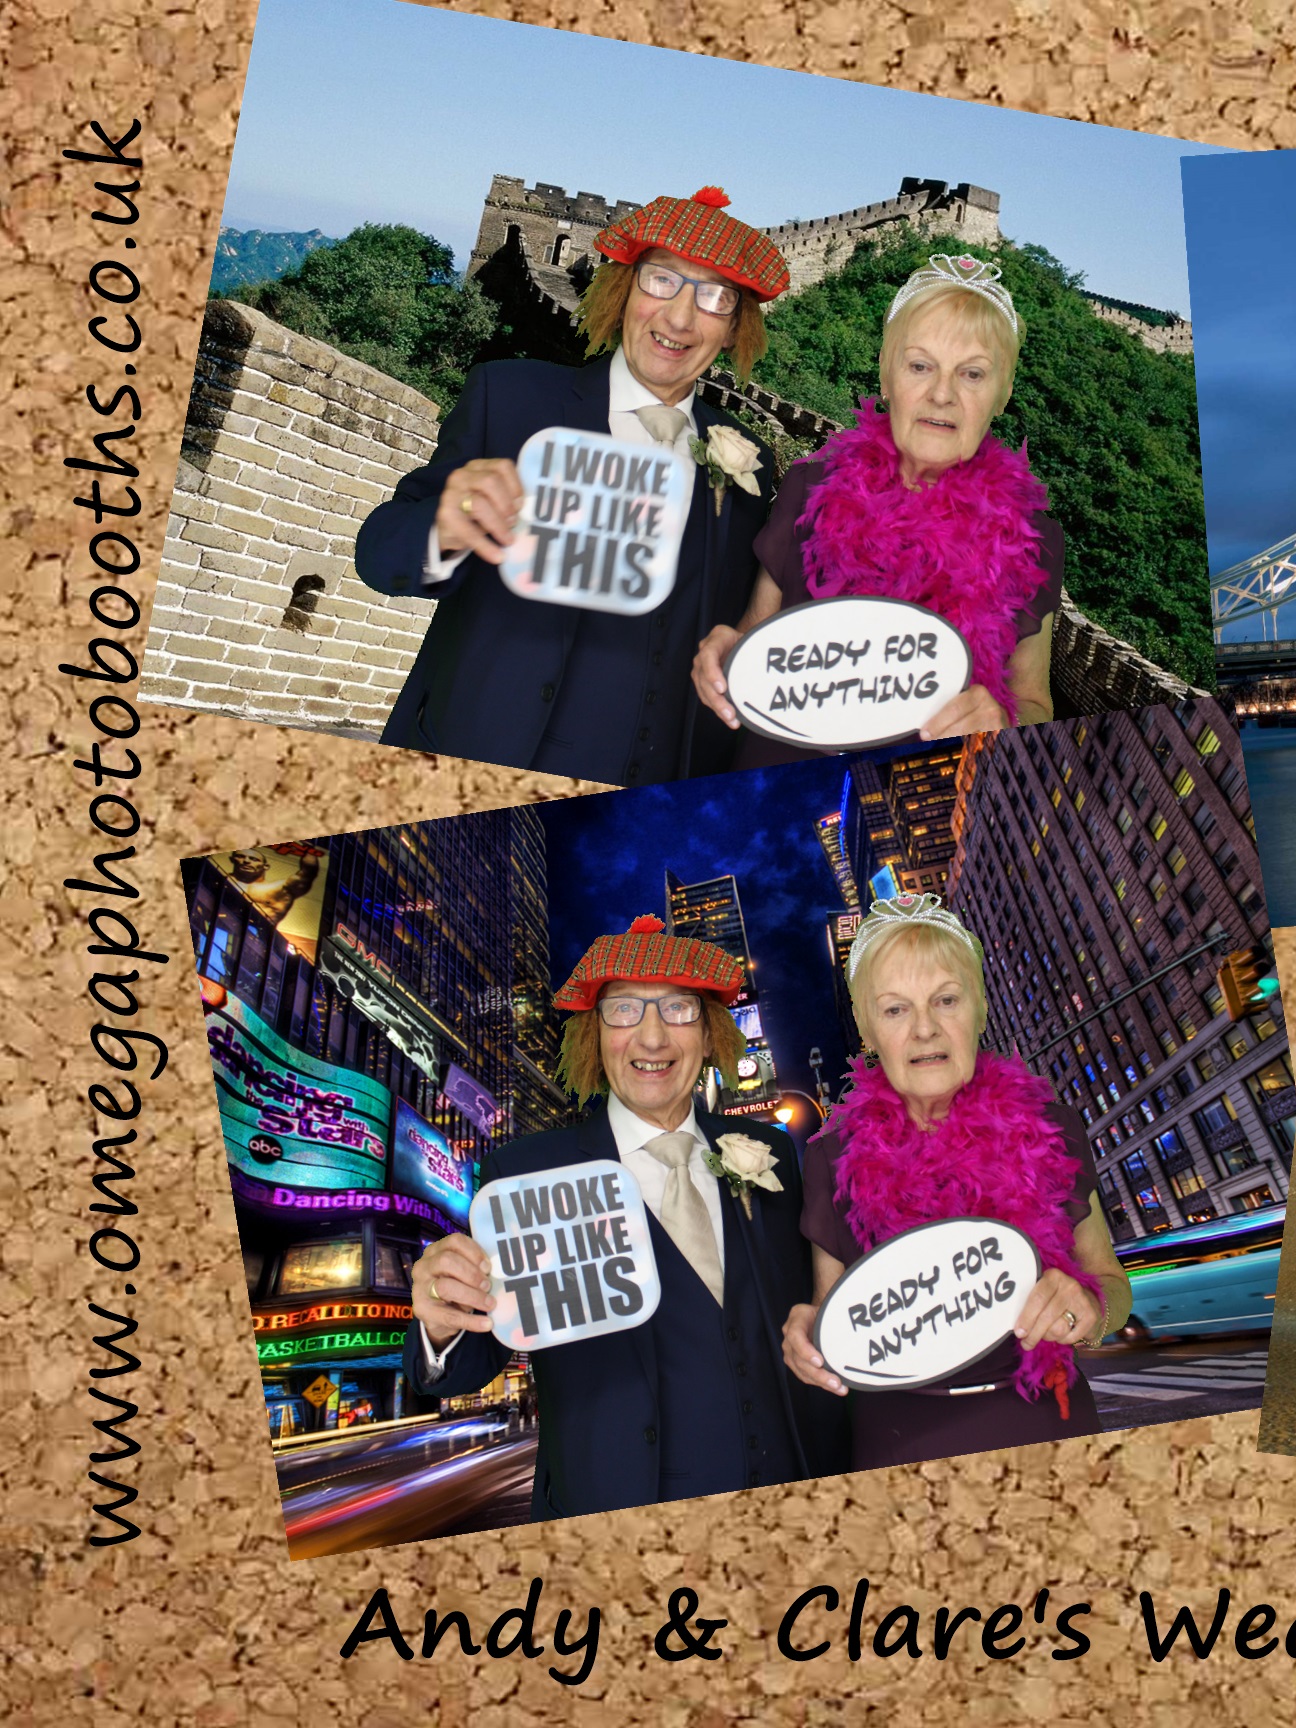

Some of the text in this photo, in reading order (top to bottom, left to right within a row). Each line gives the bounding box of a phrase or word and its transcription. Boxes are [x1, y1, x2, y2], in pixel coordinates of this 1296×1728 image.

[540, 441, 672, 496] I WOKE
[534, 485, 665, 538] UP LIKE
[529, 524, 656, 600] THIS
[766, 632, 938, 674] READY FOR
[769, 671, 940, 711] ANYTHING
[337, 922, 391, 983] GMC
[368, 979, 400, 1012] YUKON
[400, 1009, 434, 1040] DENALI
[206, 1024, 354, 1124] dancing
[249, 1139, 282, 1157] abc
[257, 1104, 386, 1159] stars
[342, 1117, 370, 1131] with
[272, 1187, 390, 1212] Dancing
[393, 1194, 432, 1220] With
[488, 1173, 625, 1234] I WOKE
[496, 1215, 633, 1277] UP LIKE
[503, 1256, 644, 1338] THIS
[848, 1237, 1003, 1331] READY FOR
[271, 1304, 350, 1329] RECALL
[352, 1304, 380, 1318] TO
[384, 1305, 413, 1319] INC
[868, 1271, 1016, 1366] ANYTHING
